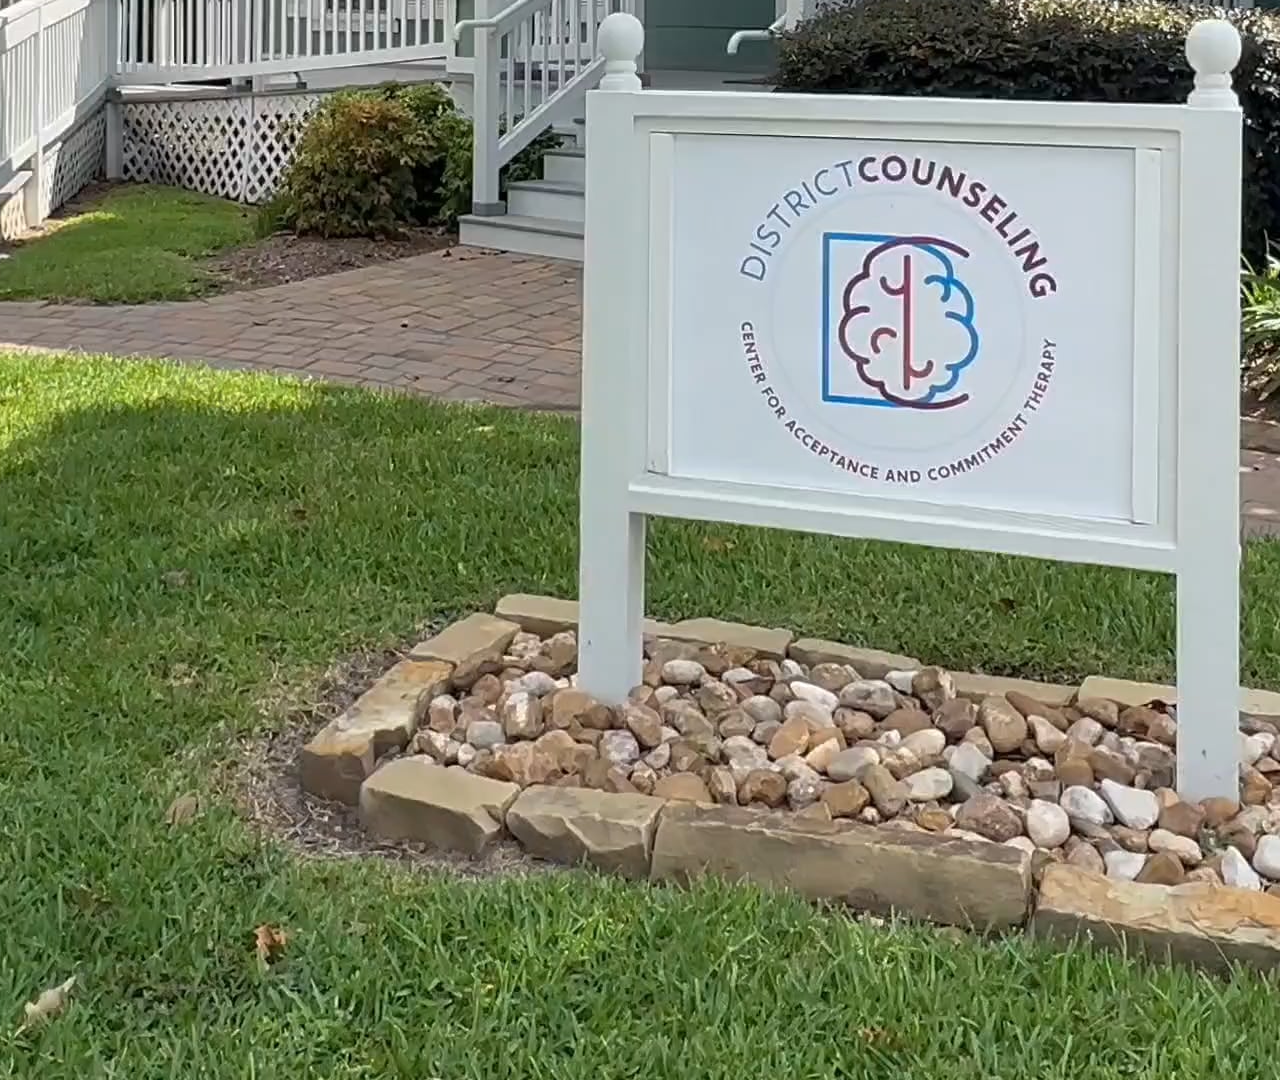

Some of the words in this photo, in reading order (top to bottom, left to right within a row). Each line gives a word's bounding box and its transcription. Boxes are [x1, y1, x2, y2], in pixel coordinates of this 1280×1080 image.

[741, 321, 766, 384] CENTER
[761, 386, 787, 419] FOR
[784, 420, 880, 479] ACCEPTANCE
[885, 470, 922, 483] AND
[927, 413, 1028, 481] COMMITMENT
[1023, 338, 1057, 413] THERAPY
